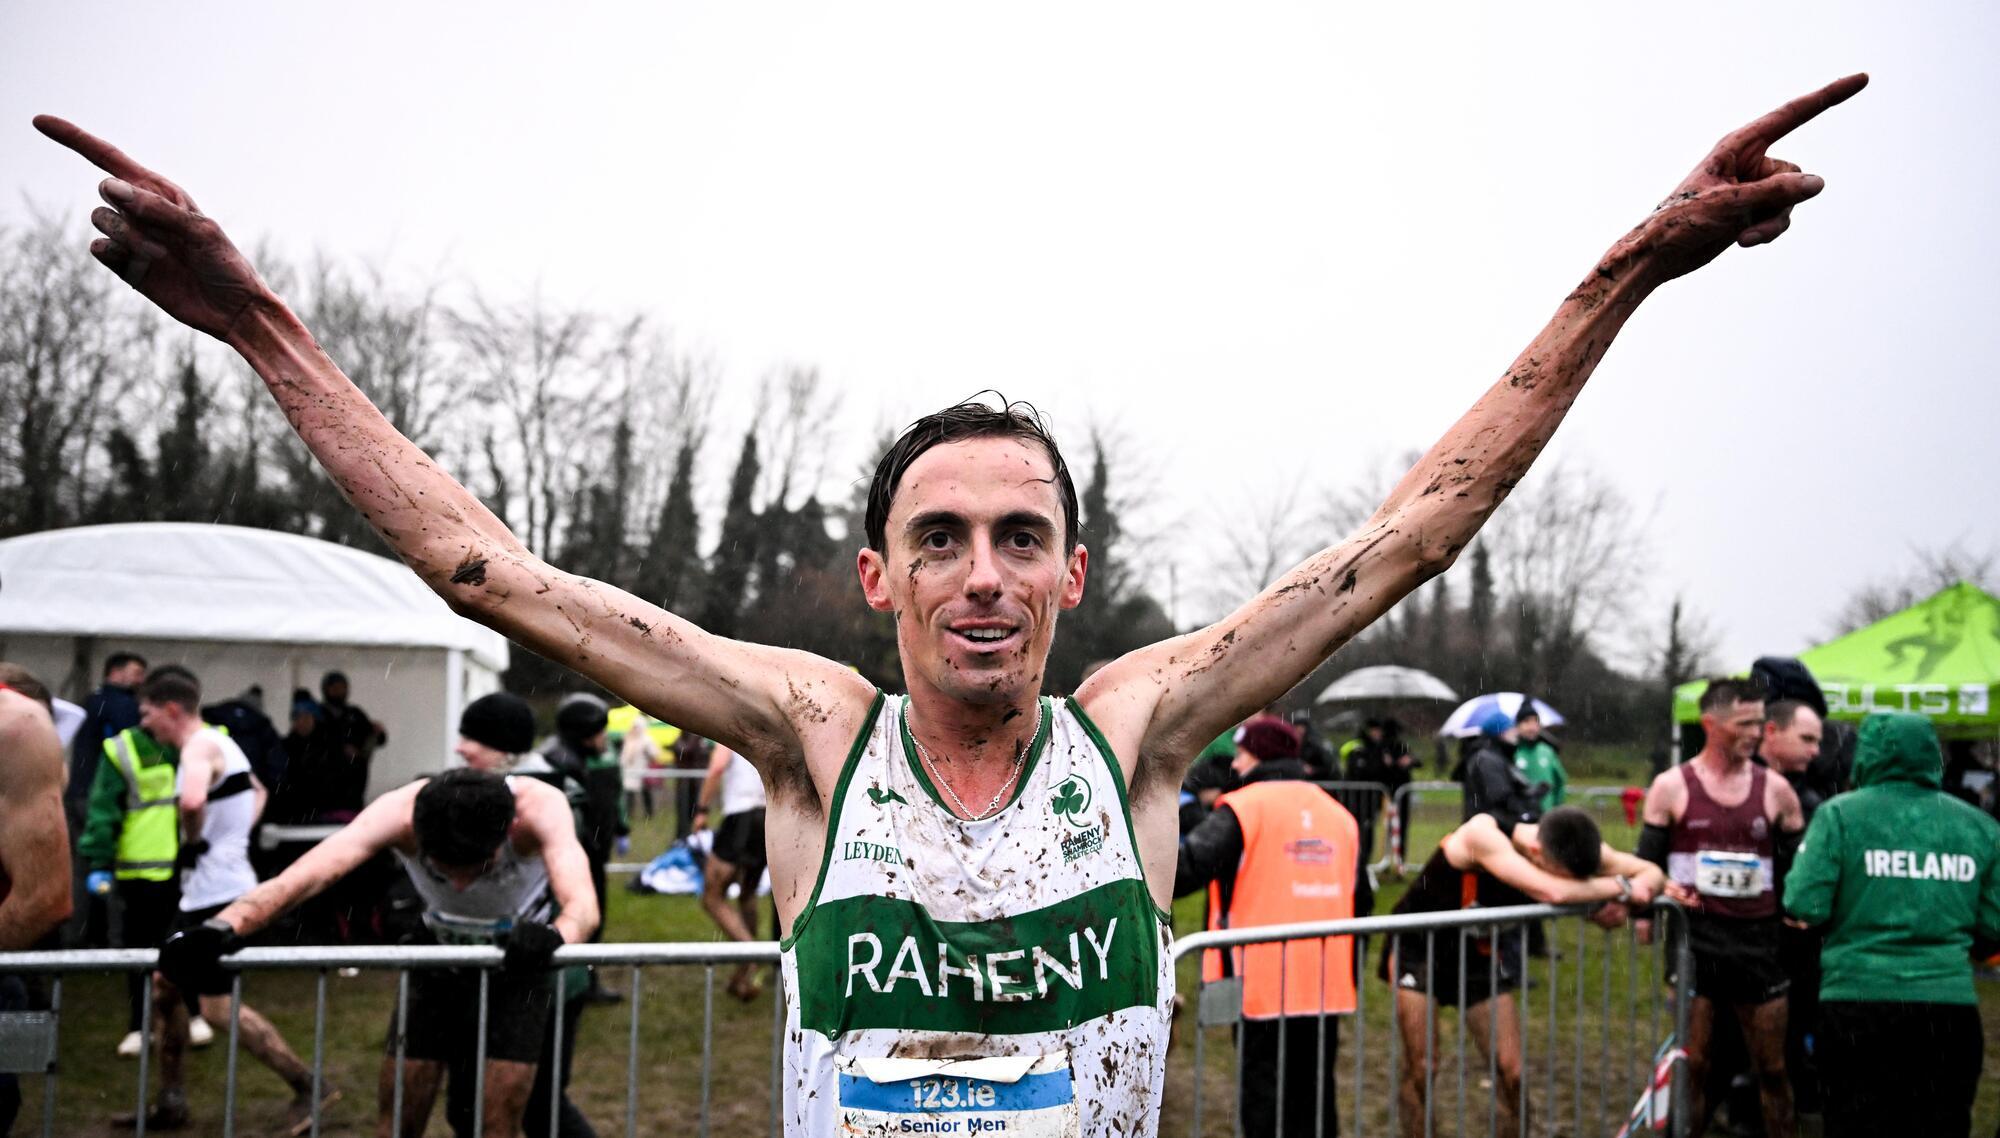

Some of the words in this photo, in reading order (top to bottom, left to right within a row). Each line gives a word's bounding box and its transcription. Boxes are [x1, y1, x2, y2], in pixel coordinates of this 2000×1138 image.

[1060, 825, 1100, 851] RAHENY
[1864, 849, 1976, 882] IRELAND
[845, 916, 1118, 1002] RAHENY
[910, 1079, 996, 1108] 123.ie
[900, 1117, 961, 1133] Senior
[967, 1117, 1006, 1134] Men
